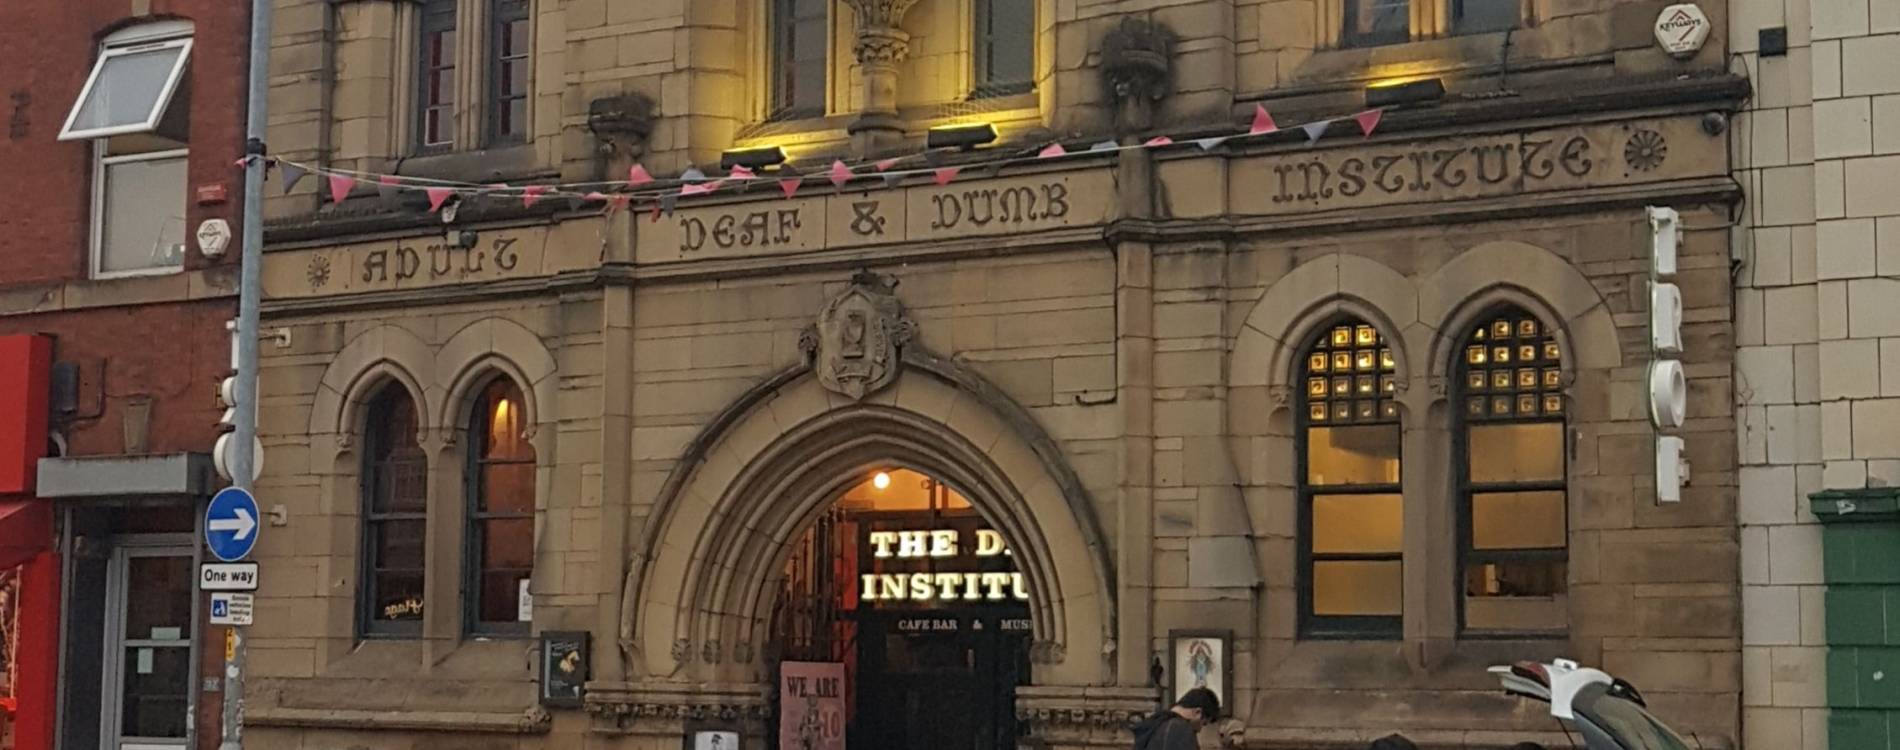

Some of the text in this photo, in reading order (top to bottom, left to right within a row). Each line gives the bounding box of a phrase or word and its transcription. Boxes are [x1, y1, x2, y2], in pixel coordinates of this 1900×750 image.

[362, 134, 1594, 283] ADULT DEAF & DUMB INSTITUTE
[870, 529, 1012, 557] THE D
[204, 569, 254, 584] One way
[932, 619, 957, 631] BAR
[972, 619, 983, 631] &
[787, 676, 840, 698] WE ARE
